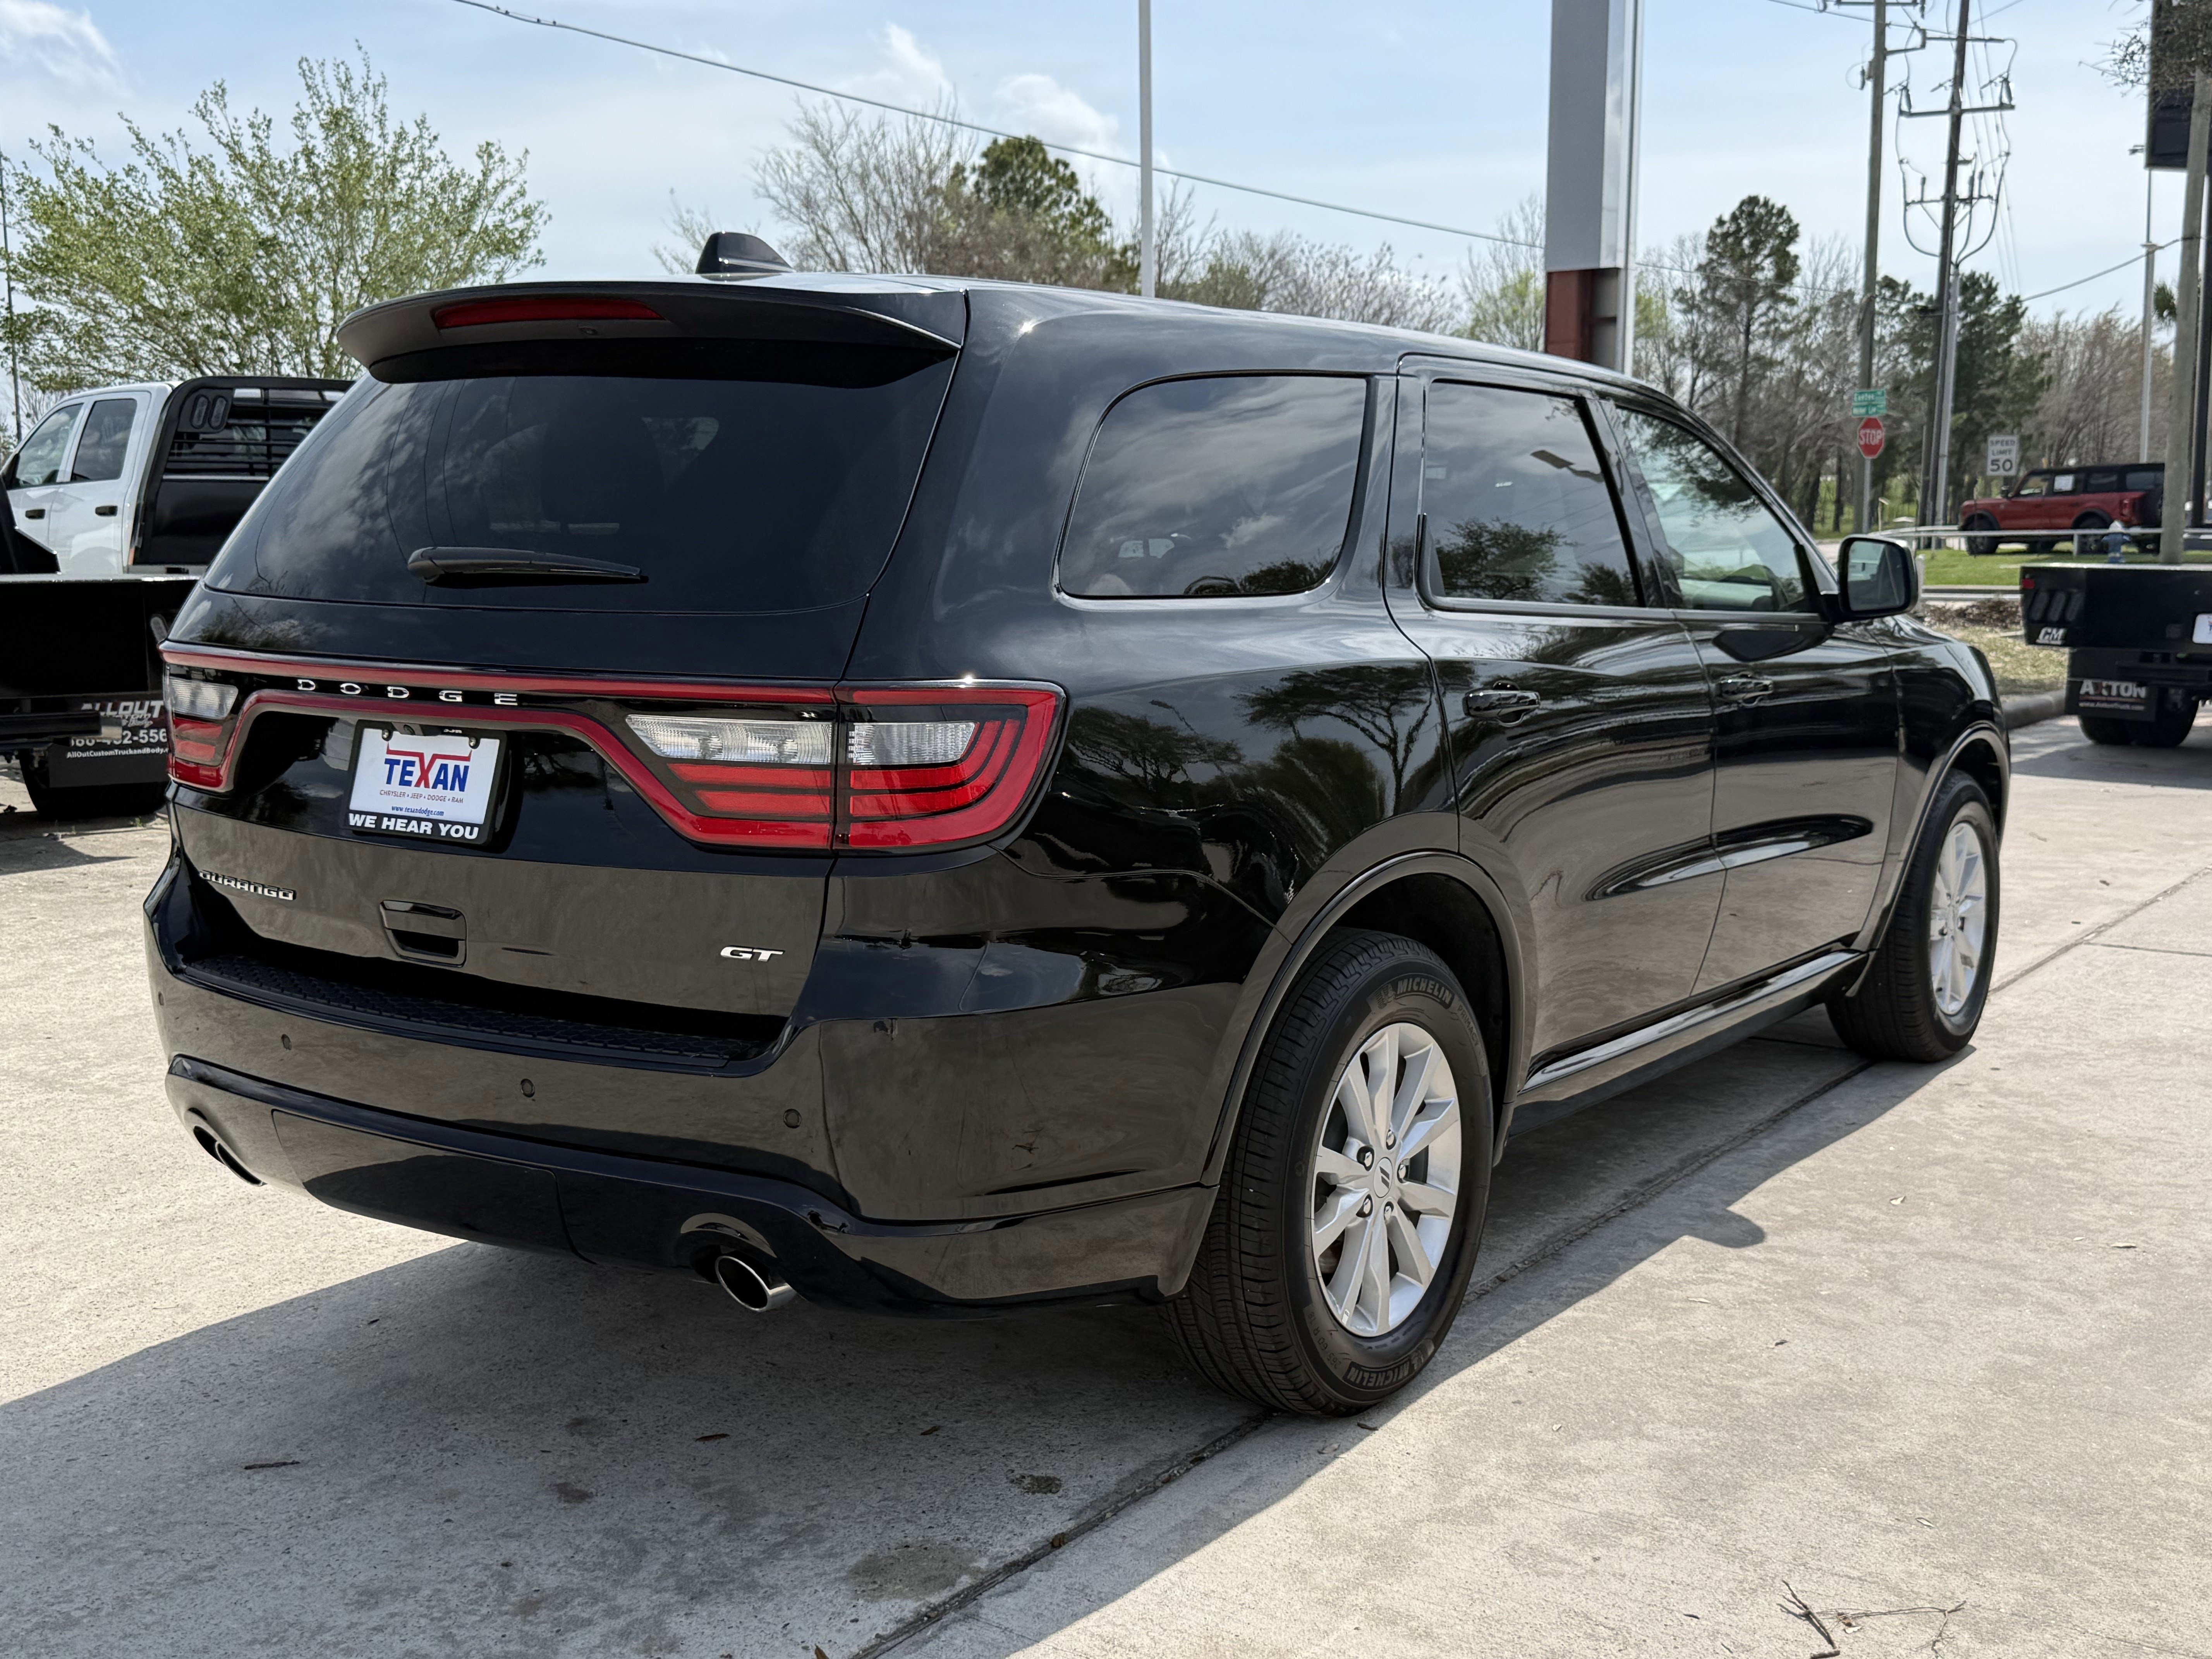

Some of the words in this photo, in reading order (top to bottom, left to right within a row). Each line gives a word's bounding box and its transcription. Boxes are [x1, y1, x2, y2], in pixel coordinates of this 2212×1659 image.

[1859, 429, 1882, 445] STOP
[1990, 459, 2013, 472] 50
[297, 679, 518, 706] DODGE
[384, 749, 472, 792] TEXAN
[380, 790, 406, 798] CHRYSLER
[349, 813, 377, 828] WE
[381, 817, 433, 835] HEAR
[438, 823, 479, 840] YOU
[199, 870, 295, 900] DURANGO
[720, 946, 785, 962] GT
[1397, 977, 1452, 1005] MICHELIN
[1348, 1364, 1410, 1387] MICHELIN
